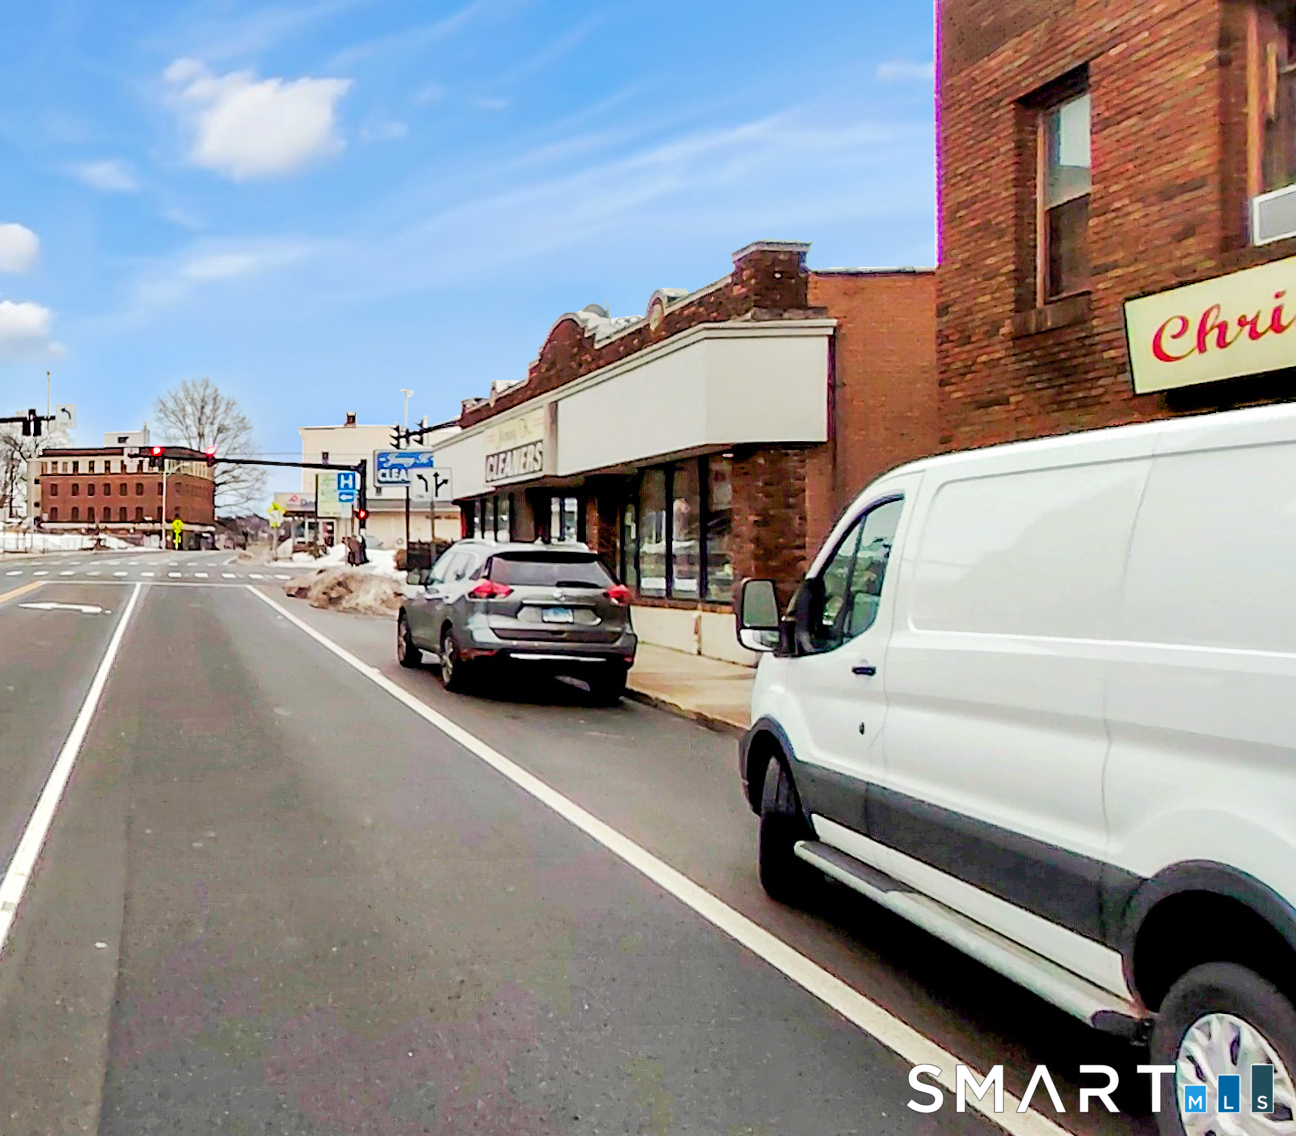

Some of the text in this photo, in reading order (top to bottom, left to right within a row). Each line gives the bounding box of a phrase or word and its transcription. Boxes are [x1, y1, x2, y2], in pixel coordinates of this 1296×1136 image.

[1152, 289, 1296, 363] Chri
[377, 468, 410, 482] CLEA
[486, 441, 543, 482] CLEANERS
[340, 473, 353, 489] H
